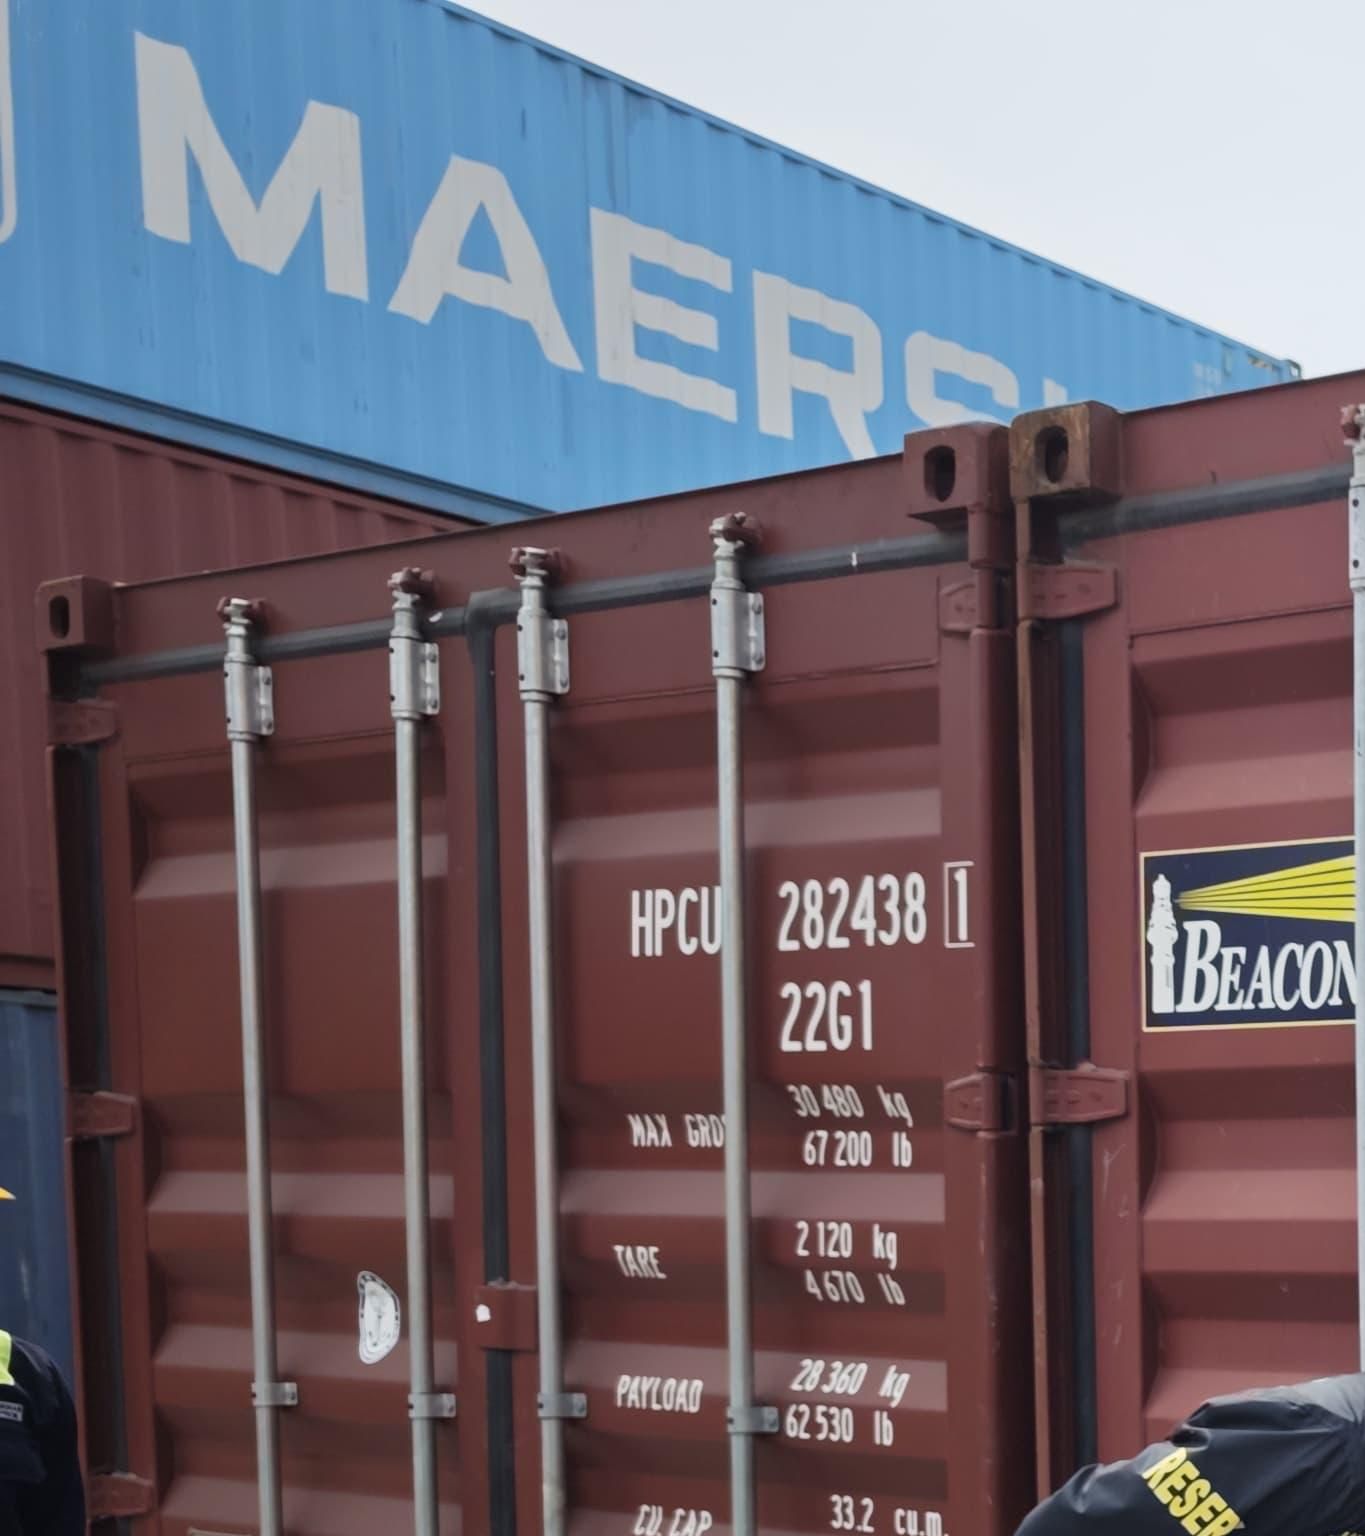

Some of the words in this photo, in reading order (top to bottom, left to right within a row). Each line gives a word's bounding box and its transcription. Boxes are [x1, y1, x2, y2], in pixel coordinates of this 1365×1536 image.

[135, 30, 1068, 460] MAERS
[631, 886, 722, 957] HPCU
[778, 872, 927, 951] 282438
[1176, 920, 1357, 1013] BEACON
[780, 979, 873, 1052] 22G1
[787, 1084, 820, 1118] 30
[822, 1084, 865, 1118] 480
[876, 1084, 914, 1128] kg
[628, 1114, 672, 1148] MAX
[803, 1131, 829, 1167] 67
[833, 1131, 872, 1167] 200
[892, 1131, 913, 1168] lb
[614, 1245, 667, 1280] TARE
[796, 1220, 810, 1257] 2
[818, 1221, 853, 1258] 120
[873, 1224, 898, 1271] kg
[804, 1269, 822, 1301] 4
[824, 1270, 865, 1304] 670
[879, 1273, 906, 1306] lb
[616, 1374, 703, 1414] PAYLOAD
[790, 1358, 821, 1392] 28
[821, 1361, 868, 1396] 360
[879, 1364, 911, 1408] kg
[785, 1404, 811, 1440] 62
[815, 1407, 854, 1443] 530
[874, 1411, 894, 1447] lb
[830, 1494, 875, 1534] 33.2
